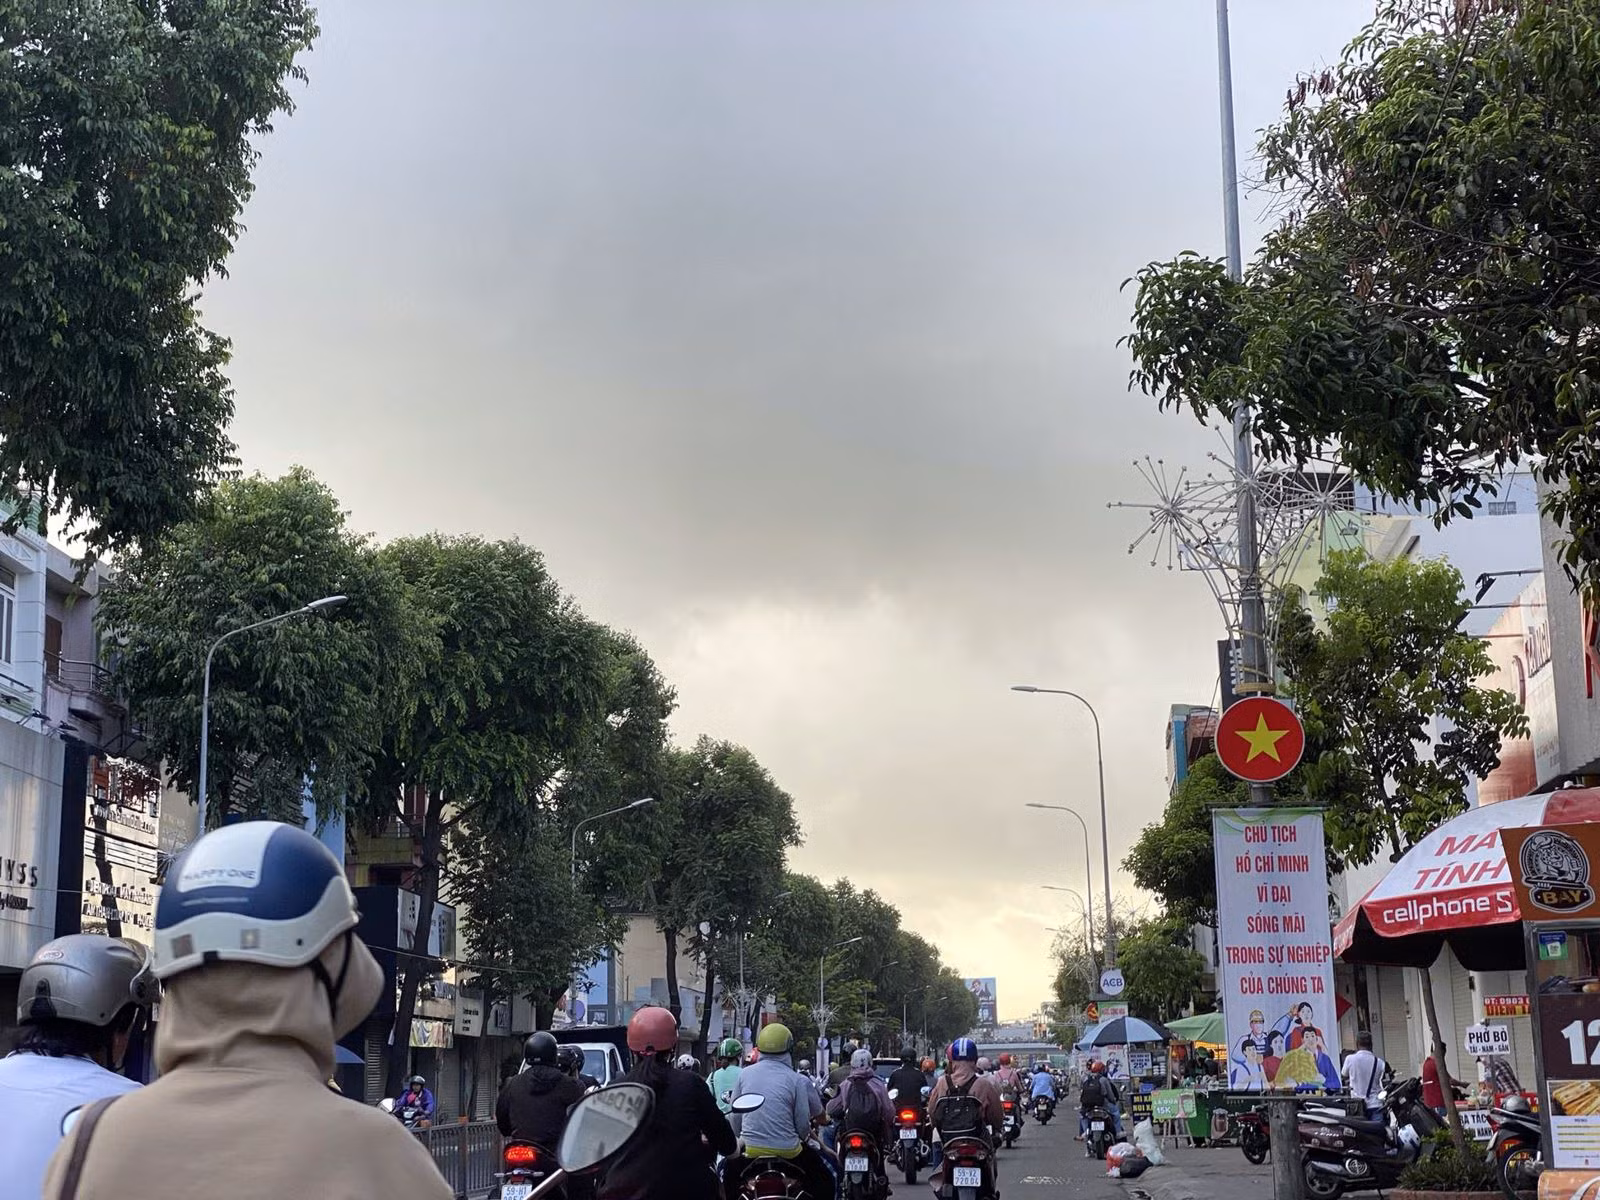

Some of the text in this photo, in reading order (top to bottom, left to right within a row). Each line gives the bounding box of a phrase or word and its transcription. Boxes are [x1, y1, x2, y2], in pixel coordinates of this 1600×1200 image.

[1244, 820, 1296, 846] CHỦ TỊCH
[1434, 826, 1504, 857] MÁ
[1255, 851, 1274, 872] CHÍ
[1278, 855, 1309, 873] MINH
[1413, 858, 1507, 890] TÍNH
[1257, 882, 1291, 906] VĨ ĐẠI
[1542, 890, 1582, 904] BAY
[1247, 909, 1306, 933] SỐNG MÃI
[1225, 942, 1330, 967] TRONG SỰ NGHIỆP
[1103, 978, 1123, 987] ACB
[1240, 970, 1325, 994] CỦA CHÚNG TA
[1468, 1027, 1490, 1043] PHỞ
